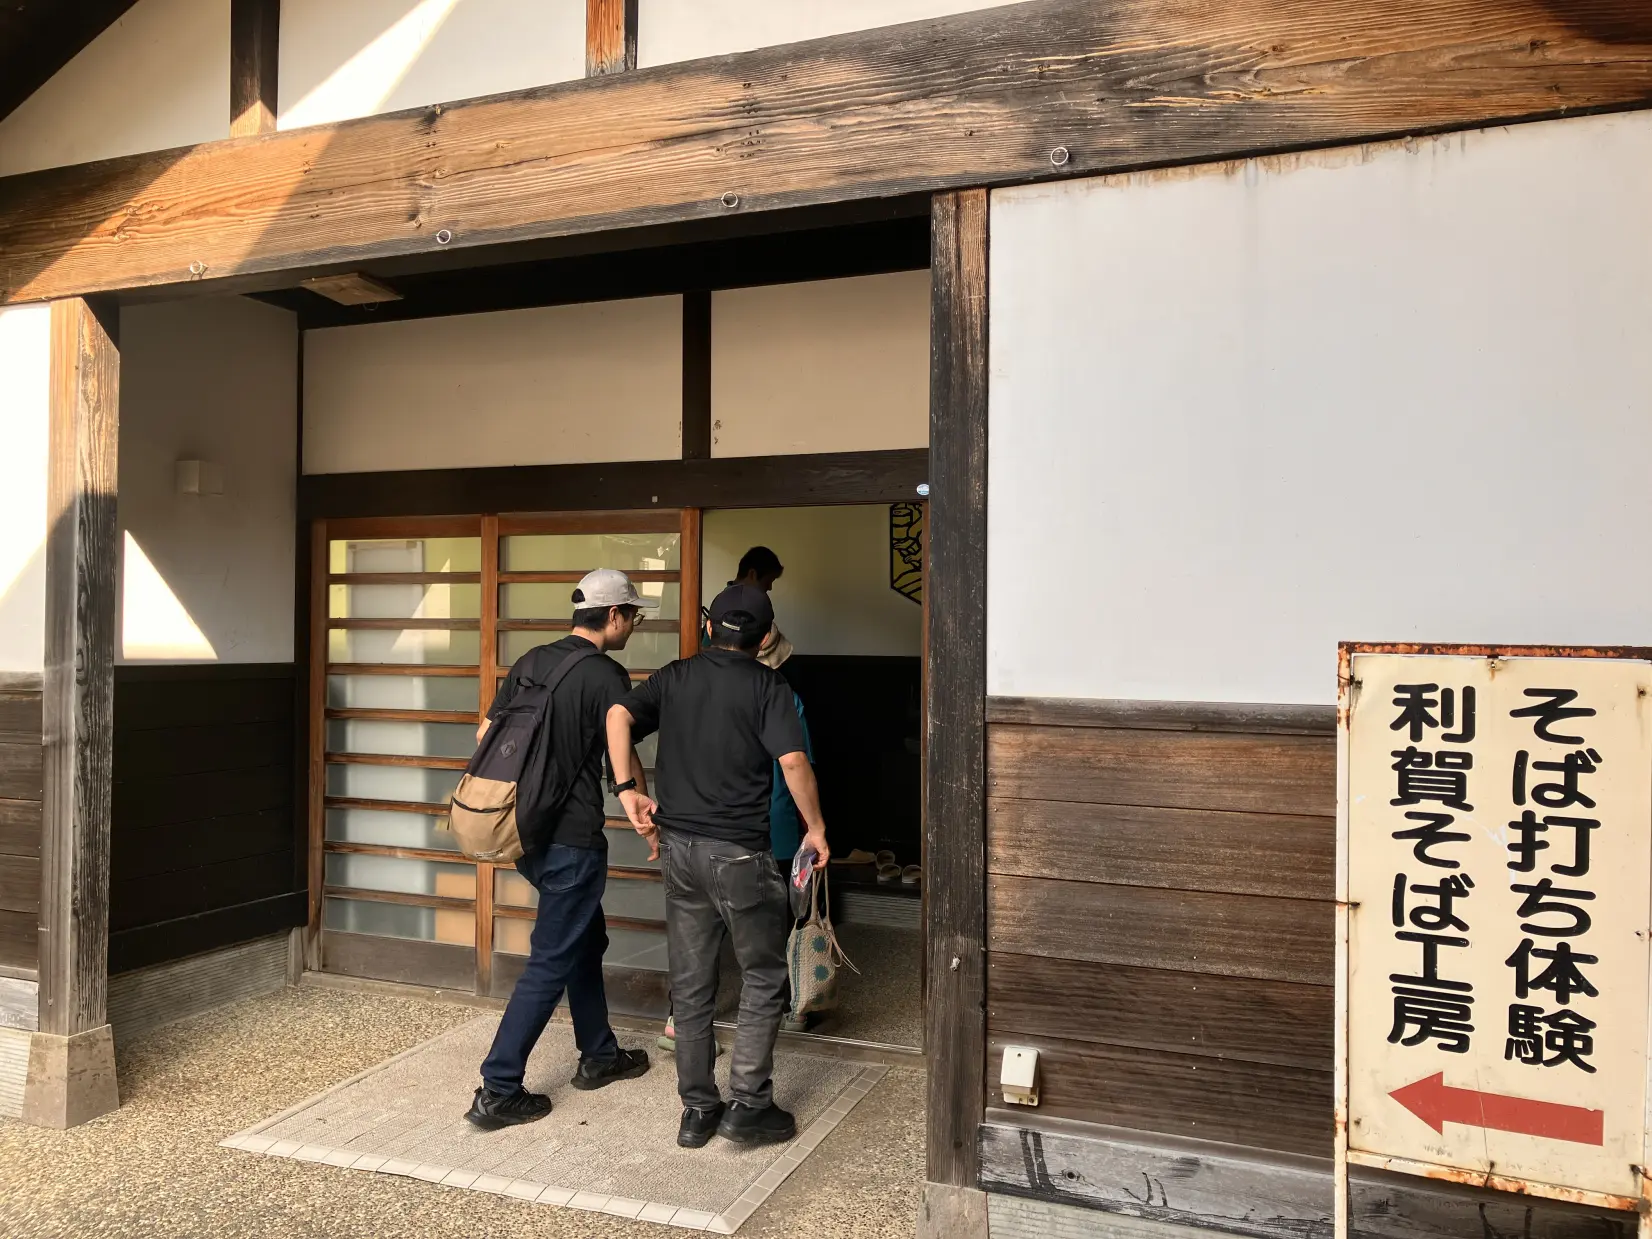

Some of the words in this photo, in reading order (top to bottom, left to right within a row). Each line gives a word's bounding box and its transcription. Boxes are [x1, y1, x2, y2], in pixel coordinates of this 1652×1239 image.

[1387, 682, 1476, 1054] 利賀そば工房
[1504, 688, 1603, 1074] そば打ち体験
